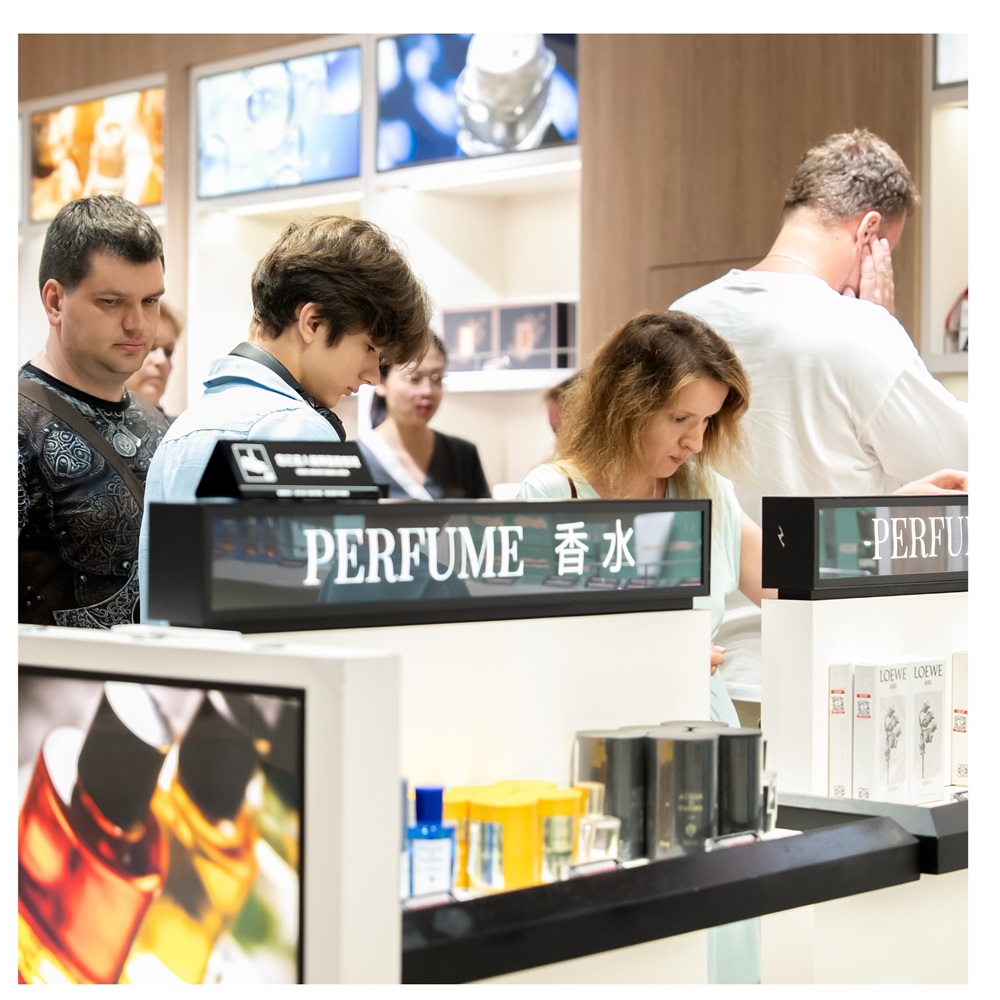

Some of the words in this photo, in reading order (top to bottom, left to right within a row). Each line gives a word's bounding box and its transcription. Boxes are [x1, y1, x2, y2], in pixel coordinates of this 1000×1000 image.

[303, 525, 524, 586] PERFUME
[554, 518, 636, 577] 香水
[871, 516, 968, 560] PERFU
[880, 667, 907, 683] LOEWE
[914, 664, 943, 679] LOEWE
